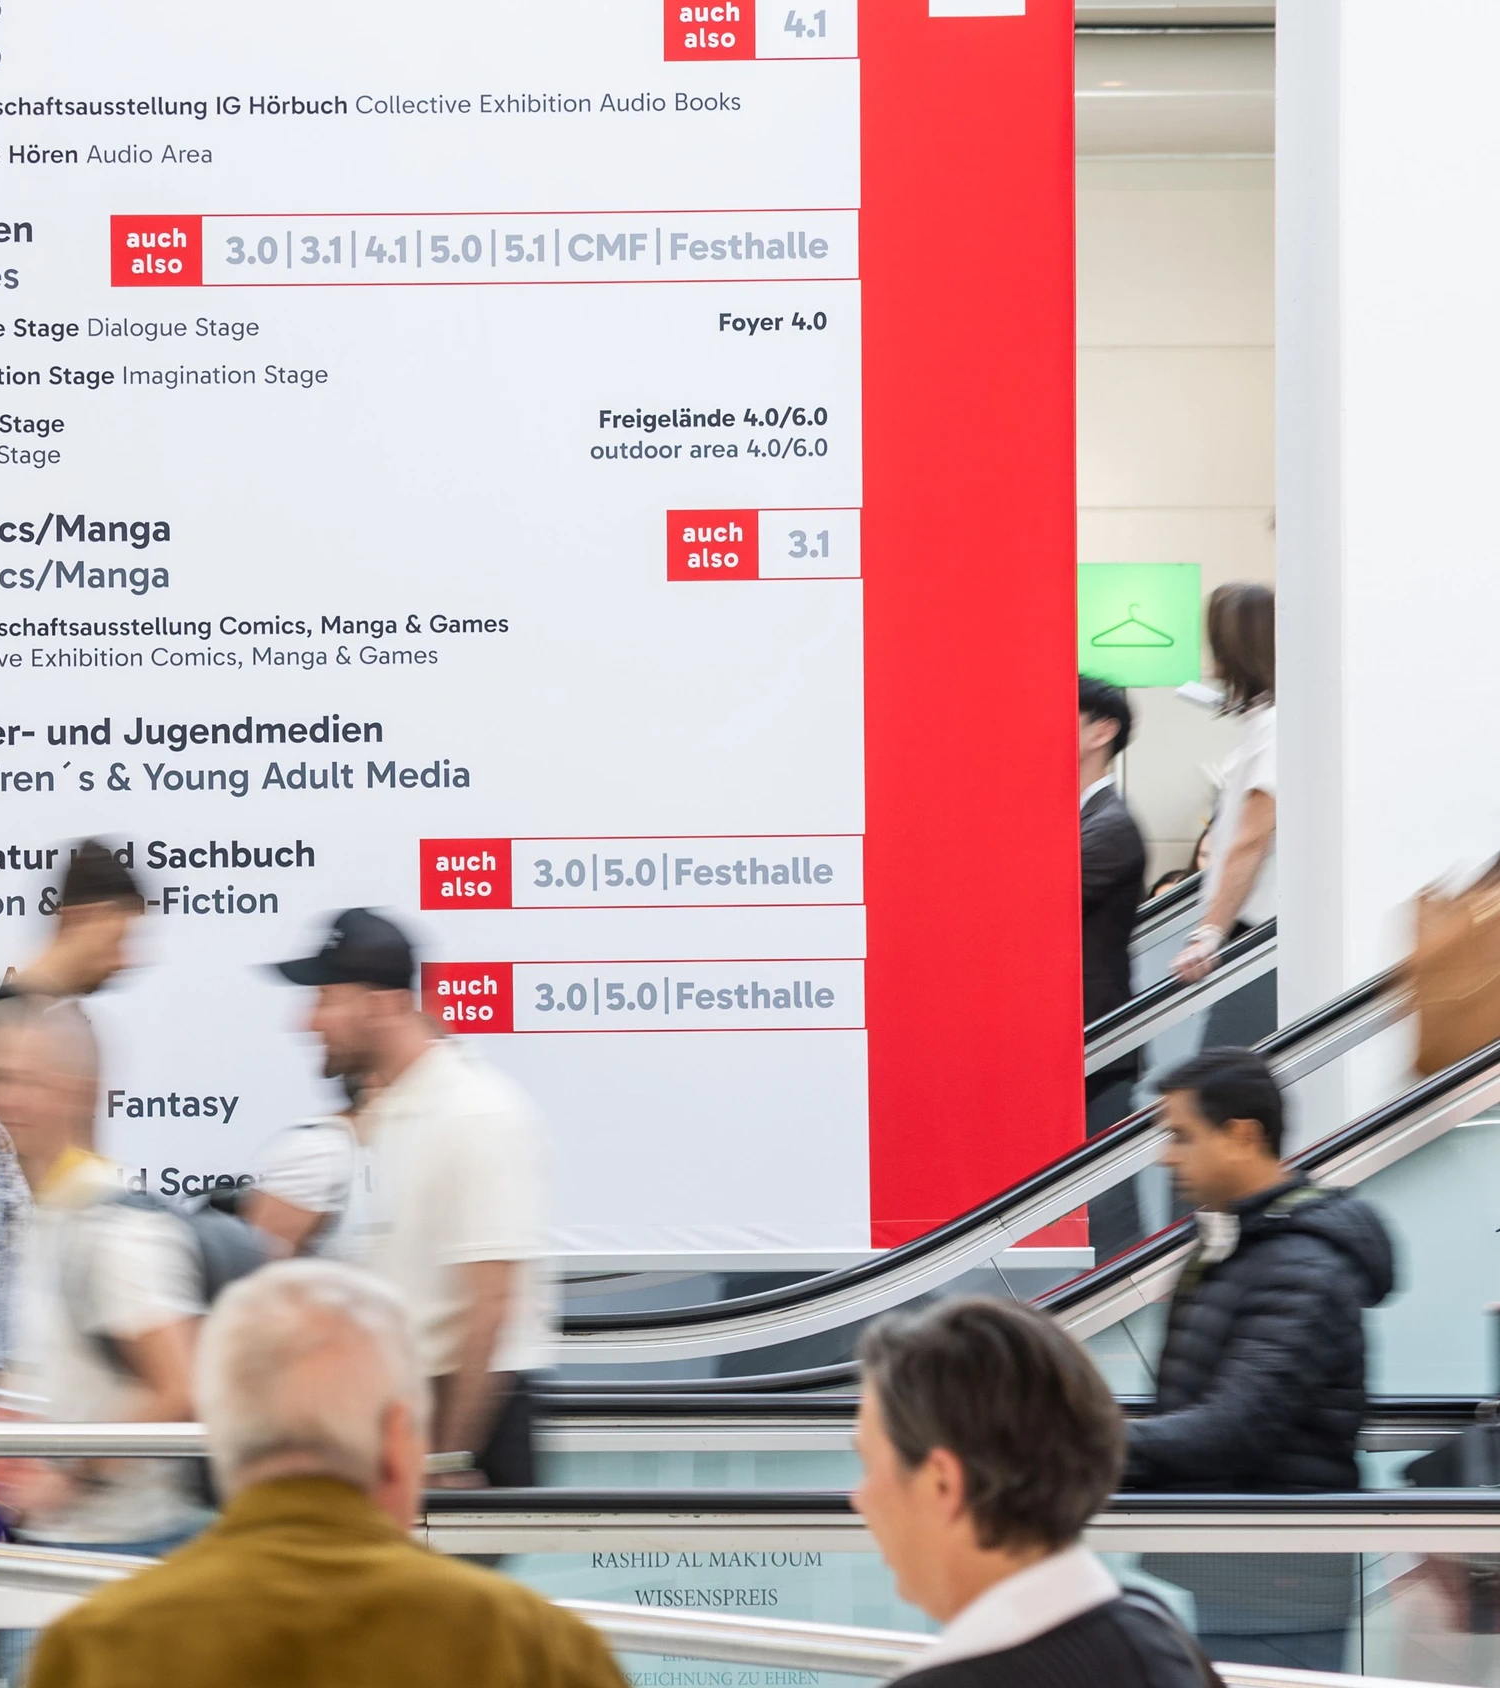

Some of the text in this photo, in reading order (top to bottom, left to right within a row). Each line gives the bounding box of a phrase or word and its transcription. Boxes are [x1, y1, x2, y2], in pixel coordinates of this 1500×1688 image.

[679, 1, 740, 23] auch
[783, 9, 826, 39] 4.1
[684, 27, 736, 49] also
[216, 95, 242, 116] IG
[249, 95, 348, 115] Hörbuch
[355, 94, 472, 115] Collective
[480, 93, 591, 113] Exhibition
[599, 92, 666, 112] Audio
[675, 91, 741, 112] Books
[9, 144, 78, 164] Hören
[86, 143, 153, 164] Audio
[160, 144, 213, 164] Area
[126, 227, 187, 248] auch
[225, 230, 829, 266] 3.0 3.1 4.1 5.0 5.1 CMF Festhalle
[131, 253, 183, 274] also
[13, 317, 80, 343] Stage
[88, 317, 188, 342] Dialogue
[195, 317, 260, 342] Stage
[719, 311, 828, 337] Foyer 4.0
[48, 365, 115, 390] Stage
[123, 364, 256, 390] Imagination
[264, 364, 329, 389] Stage
[599, 405, 828, 434] Freigelände 4.0/6.0
[590, 436, 828, 460] outdoor area 4.0/6.0
[682, 521, 743, 543] auch
[787, 529, 829, 559] 3.1
[687, 547, 739, 569] also
[219, 614, 312, 639] Comics,
[321, 615, 397, 640] Manga
[405, 613, 422, 634] &
[429, 614, 509, 634] Games
[31, 647, 143, 668] Exhibition
[150, 646, 243, 670] Comics,
[252, 646, 327, 671] Manga
[335, 645, 352, 665] &
[359, 645, 439, 665] Games
[47, 717, 111, 746] und
[123, 713, 383, 753] Jugendmedien
[106, 762, 132, 792] &
[142, 762, 249, 798] Young
[261, 761, 354, 790] Adult
[367, 758, 470, 789] Media
[146, 839, 315, 870] Sachbuch
[435, 851, 496, 872] auch
[532, 856, 834, 888] 3.0 5.0 Festhalle
[441, 876, 492, 897] also
[37, 886, 63, 916] &
[437, 975, 498, 996] auch
[534, 980, 835, 1012] 3.0 5.0 Festhalle
[442, 1000, 494, 1021] also
[107, 1089, 240, 1125] Fantasy
[590, 1551, 823, 1569] RASHID AL MAKTOUM
[633, 1587, 779, 1608] WISSENSPREIS
[621, 1670, 820, 1688] SZEICHNUNG ZU EHREN
